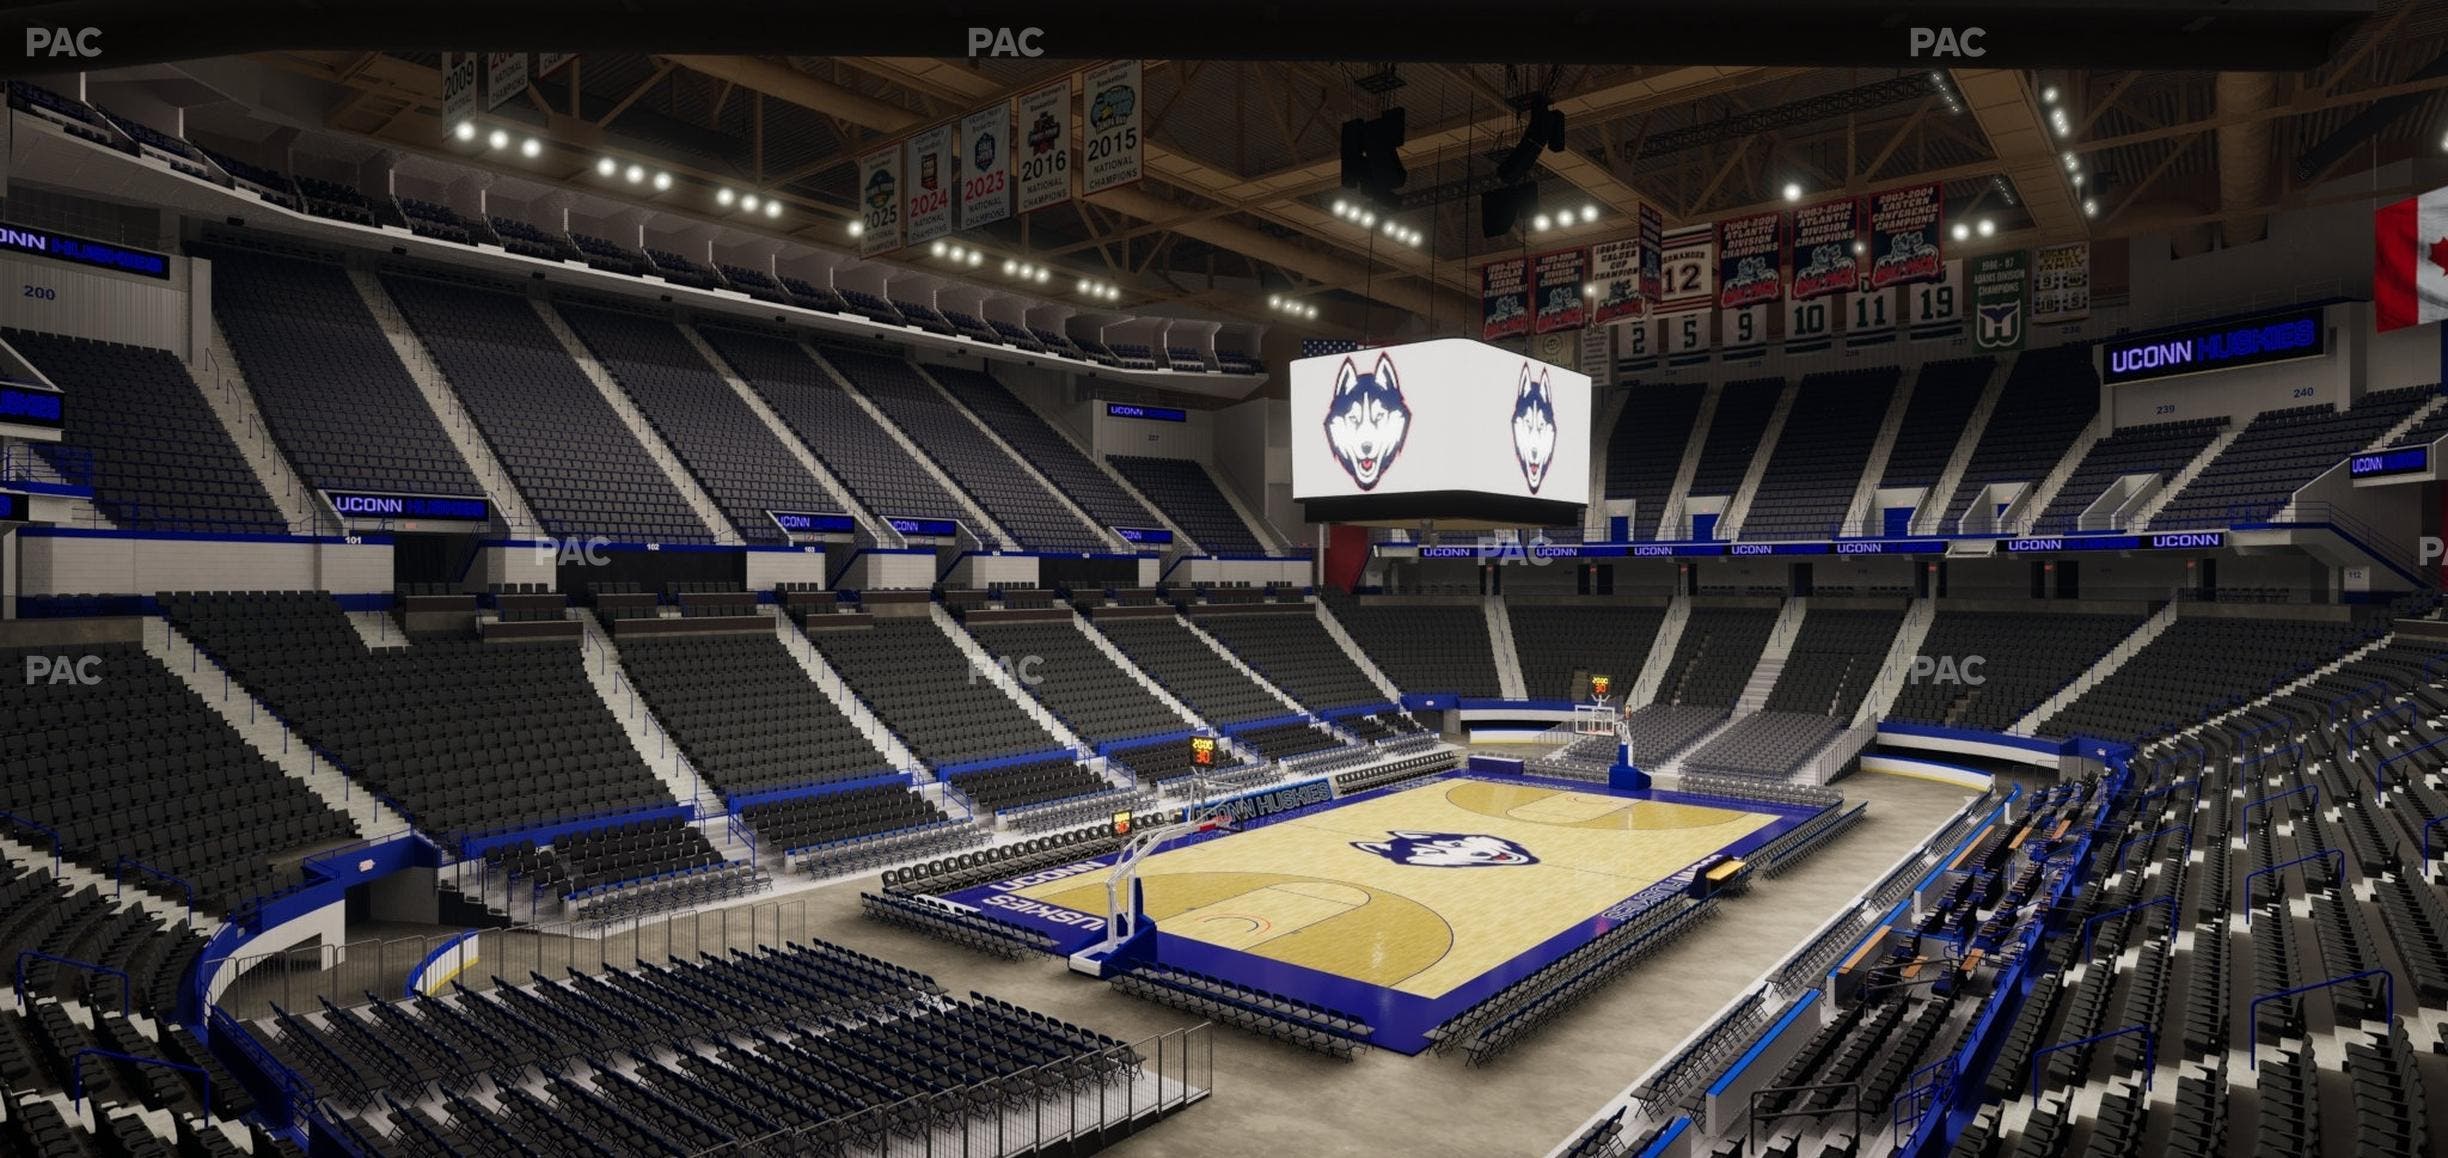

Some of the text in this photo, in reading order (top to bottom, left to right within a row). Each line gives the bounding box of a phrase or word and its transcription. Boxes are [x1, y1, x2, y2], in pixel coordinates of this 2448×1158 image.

[444, 61, 474, 101] 2009
[1089, 127, 1137, 161] 2015
[1022, 151, 1067, 182] 2016
[1093, 156, 1133, 174] NATIONAL
[966, 171, 1005, 202] 2023
[1027, 178, 1063, 194] NATIONAL
[1089, 168, 1138, 189] CHAMPIONS
[911, 189, 948, 218] 2024
[969, 197, 1002, 212] NATIONAL
[1024, 189, 1067, 209] CHAMPIONS
[1882, 198, 1931, 213] EASTERN
[864, 204, 898, 231] 2025
[914, 214, 944, 230] NATIONAL
[966, 208, 1005, 226] CHAMPIONS
[1798, 211, 1851, 228] ATLANTIC
[1873, 203, 1938, 224] CONFERENCE
[1801, 222, 1848, 238] DIVISION
[1876, 214, 1936, 231] CHAMPIONS
[1725, 225, 1775, 242] ATLANTIC
[1795, 230, 1856, 248] CHAMPIONS
[1722, 243, 1778, 259] CHAMPIONS
[1729, 236, 1771, 250] DIVISION
[1602, 250, 1636, 263] CALDER
[1610, 260, 1627, 270] CUP
[1663, 264, 1701, 293] 12
[1974, 269, 2026, 285] ADAMS DIVISION
[25, 285, 56, 301] 200
[1978, 282, 2020, 297] CHAMPIONS
[1857, 296, 1887, 328] 11
[1921, 287, 1953, 320] 19
[2041, 301, 2054, 312] 18
[1738, 313, 1752, 341] 9
[1795, 305, 1824, 335] 10
[1633, 327, 1645, 354] 2
[1684, 320, 1696, 349] 5
[2112, 318, 2317, 373] UCONN HUSKIES
[2293, 387, 2314, 398] 240
[1111, 405, 1144, 417] UCONN
[2156, 405, 2175, 415] 239
[2352, 455, 2384, 474] UCONN
[336, 496, 403, 513] UCONN
[345, 536, 362, 545] 101
[647, 542, 660, 551] 102
[1837, 543, 1882, 554] UCONN
[2008, 540, 2062, 552] UCONN
[2153, 534, 2219, 548] UCONN
[1424, 548, 1470, 557] UCONN
[1537, 547, 1577, 557] UCONN
[1634, 546, 1672, 556] UCONN
[1732, 545, 1772, 555] UCONN
[1193, 738, 1214, 750] 20:00
[1195, 750, 1211, 764] 30
[1256, 782, 1331, 816] HUSKIES
[989, 860, 1107, 892] UCONN
[981, 894, 1106, 932] USKIES
